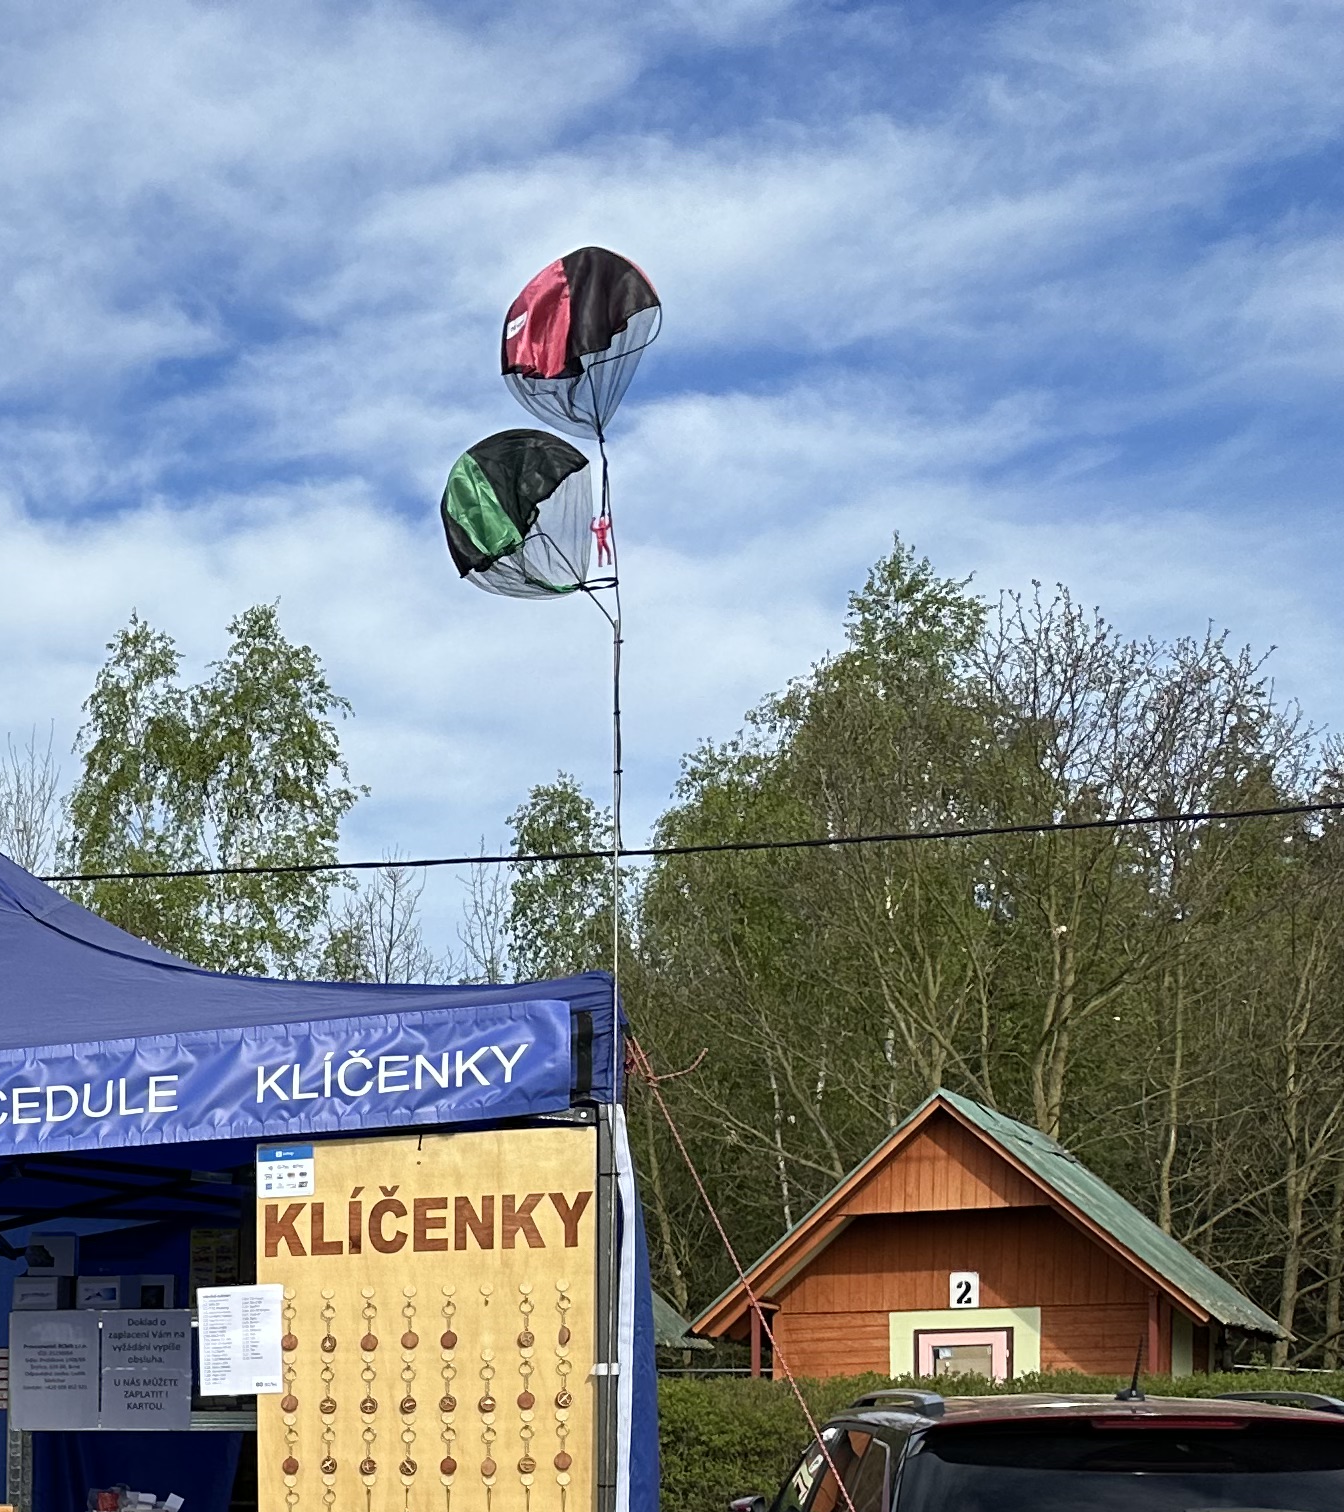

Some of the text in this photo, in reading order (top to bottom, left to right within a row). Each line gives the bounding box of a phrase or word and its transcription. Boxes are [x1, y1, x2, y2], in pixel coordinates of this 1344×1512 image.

[256, 1043, 529, 1105] KLÍČENKY
[264, 1184, 593, 1258] KLÍČENKY
[956, 1281, 973, 1305] 2
[127, 1318, 157, 1326] Doklad
[108, 1329, 150, 1339] zaplacení
[112, 1342, 150, 1352] vyžádání
[114, 1377, 179, 1387] U NÁS MŮŽETE
[123, 1390, 163, 1399] ZAPLATIT
